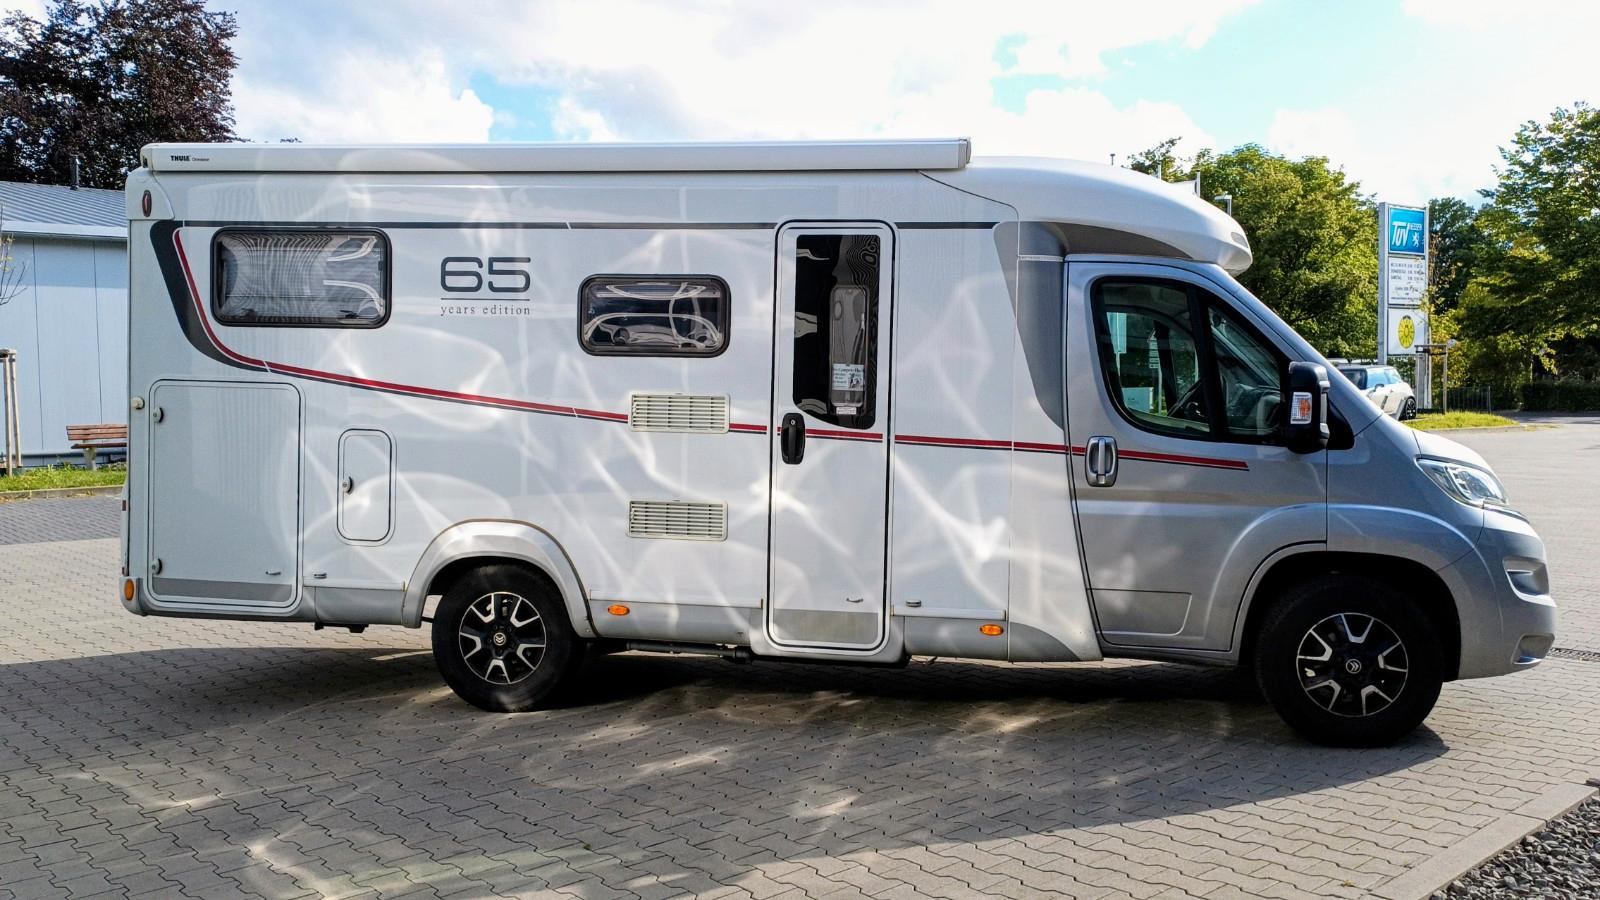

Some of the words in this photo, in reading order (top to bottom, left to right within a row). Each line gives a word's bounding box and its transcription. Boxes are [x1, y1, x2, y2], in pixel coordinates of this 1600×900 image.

[440, 256, 531, 293] 65
[440, 306, 476, 317] years
[482, 304, 531, 316] edition
